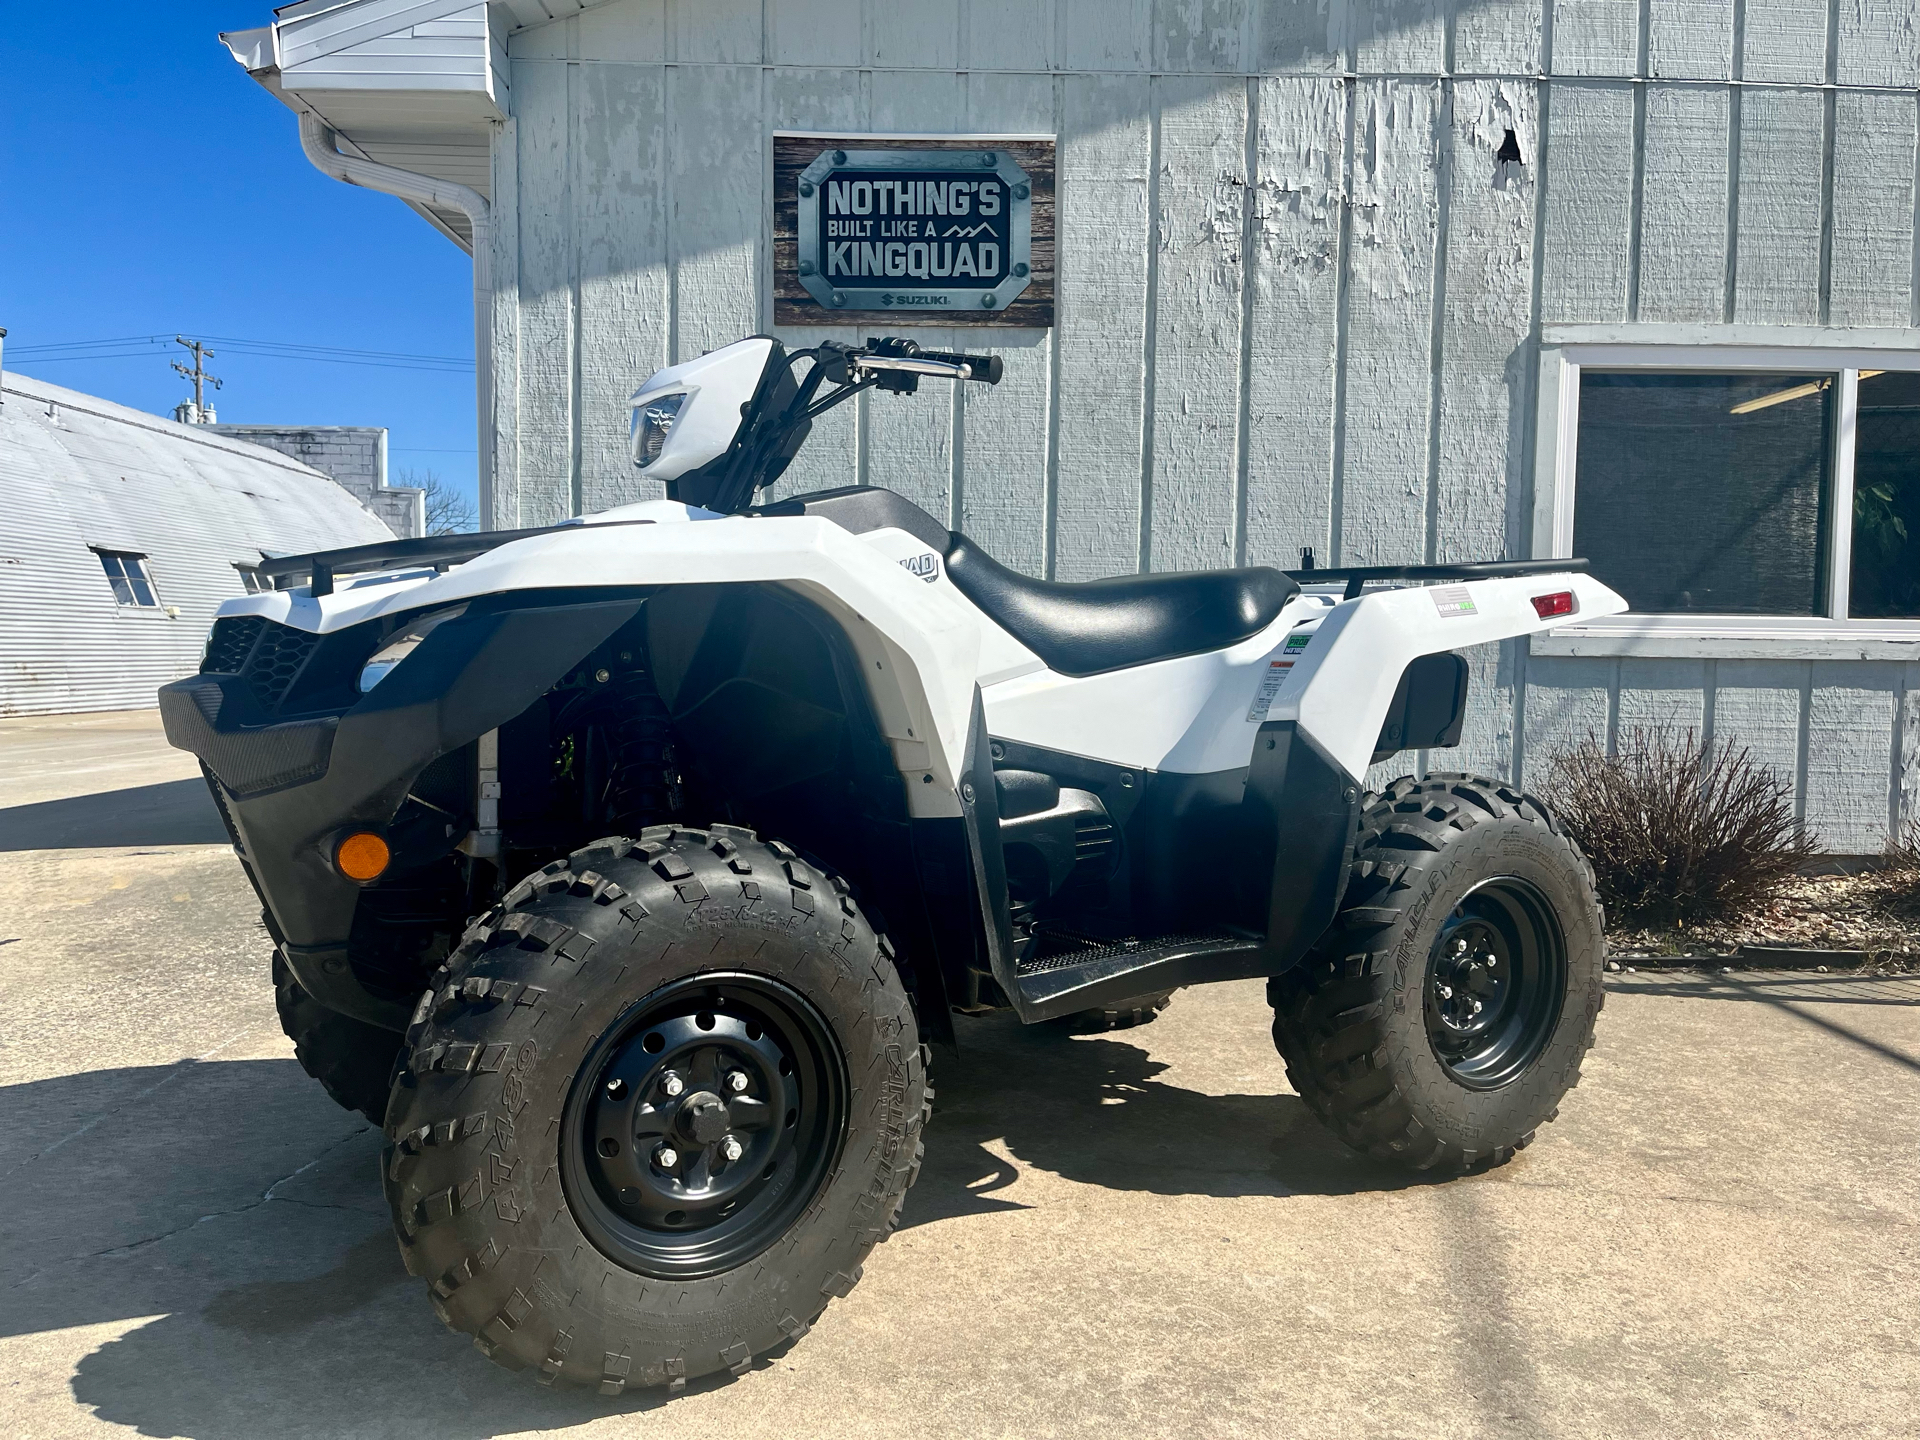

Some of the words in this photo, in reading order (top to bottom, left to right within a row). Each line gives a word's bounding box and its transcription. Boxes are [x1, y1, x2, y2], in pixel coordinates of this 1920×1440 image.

[828, 181, 1001, 216] NOTHING'S
[828, 221, 874, 237] BUILT
[881, 221, 918, 237] LIKE
[924, 221, 937, 238] A
[828, 241, 1000, 280] KINGQUAD
[896, 295, 948, 305] SUZUKI
[1393, 870, 1442, 992] CARLISLE
[490, 1038, 538, 1224] AT489
[867, 1042, 905, 1202] CARLISLE
